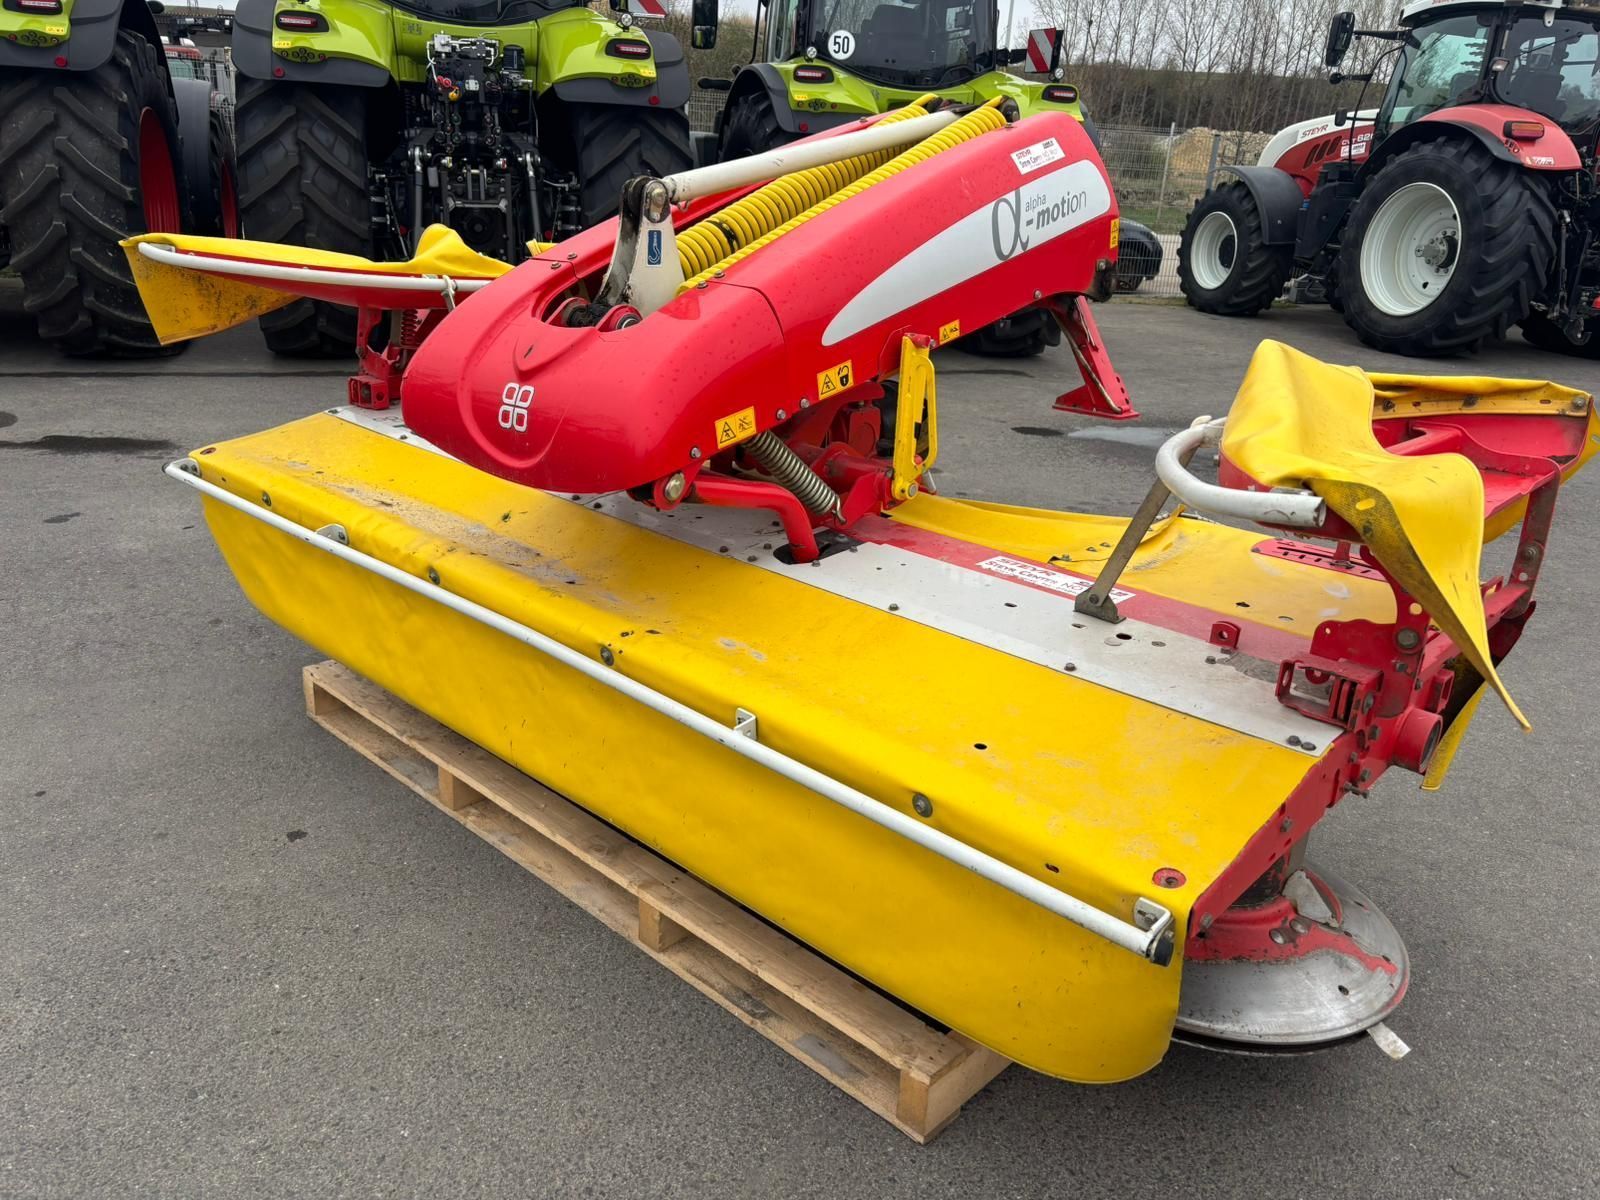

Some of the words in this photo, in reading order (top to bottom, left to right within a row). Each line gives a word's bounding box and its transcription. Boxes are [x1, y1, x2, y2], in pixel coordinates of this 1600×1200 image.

[833, 36, 849, 54] 50
[1301, 125, 1328, 138] STEYR
[1025, 193, 1047, 213] alpha
[997, 558, 1056, 576] STEYR
